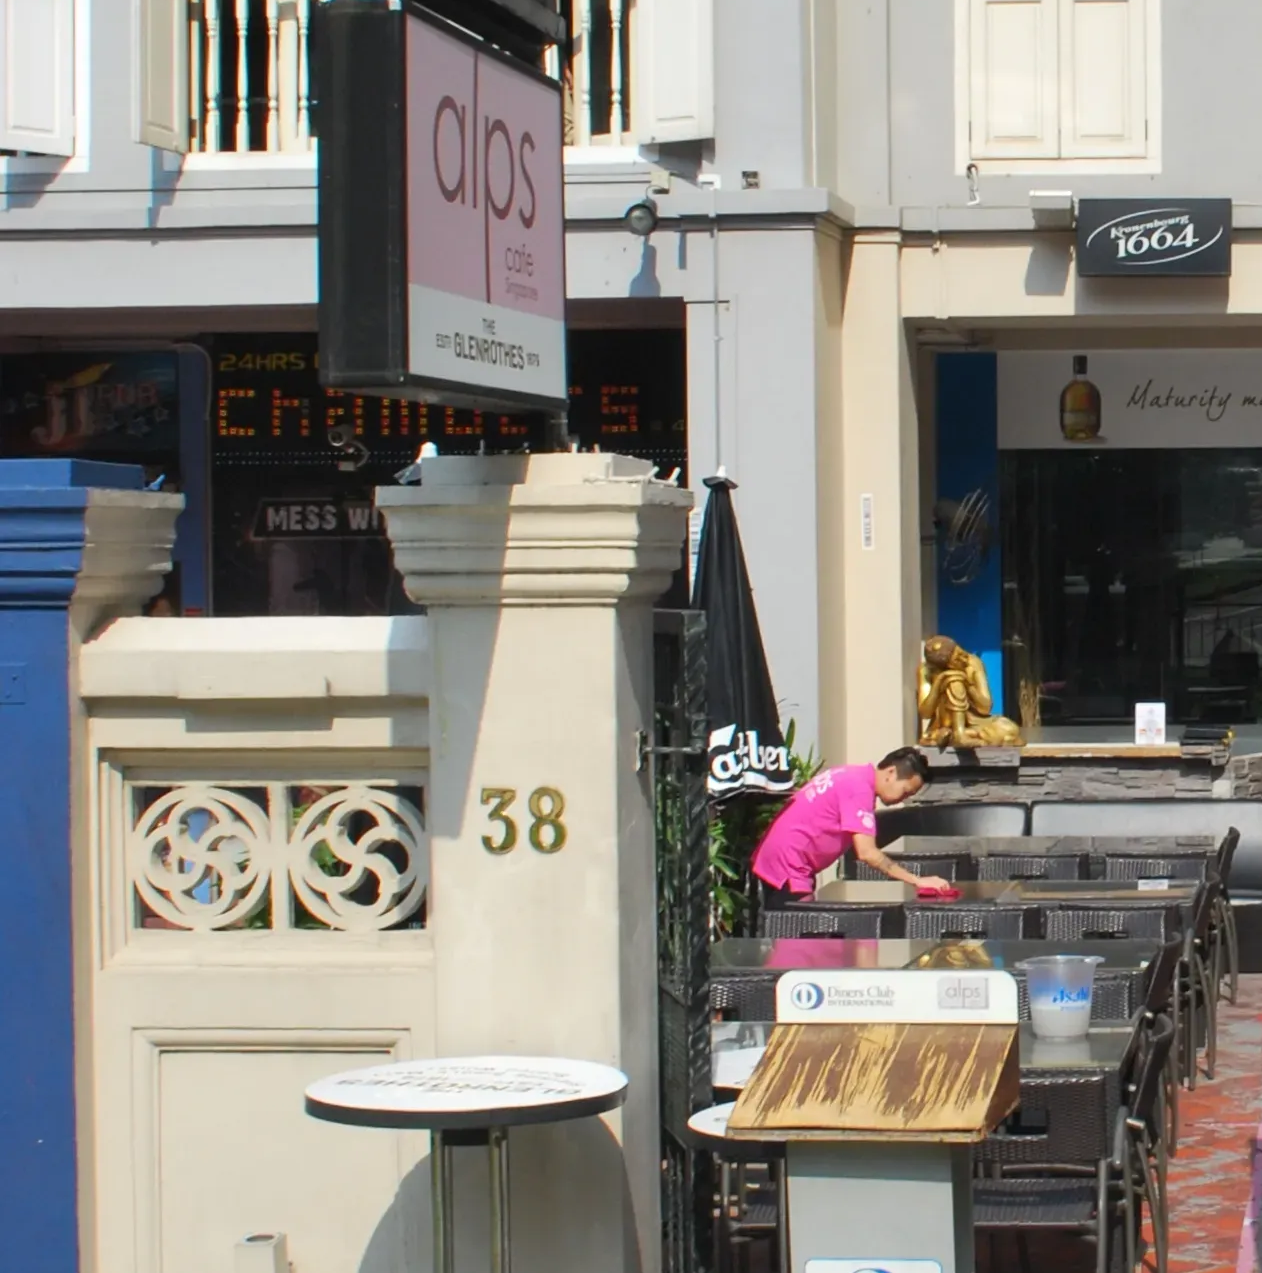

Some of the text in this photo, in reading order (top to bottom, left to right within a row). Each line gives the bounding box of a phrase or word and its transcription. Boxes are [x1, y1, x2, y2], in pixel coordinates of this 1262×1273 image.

[433, 51, 537, 304] alps
[1110, 214, 1190, 239] Kronenbourg
[1115, 223, 1200, 258] 1664
[219, 353, 306, 372] 24HRS
[454, 332, 525, 370] GLENROTHES
[1127, 379, 1232, 422] Maturity
[266, 504, 338, 531] MESS
[479, 786, 568, 855] 38
[827, 978, 982, 1009] Diners Club alps
